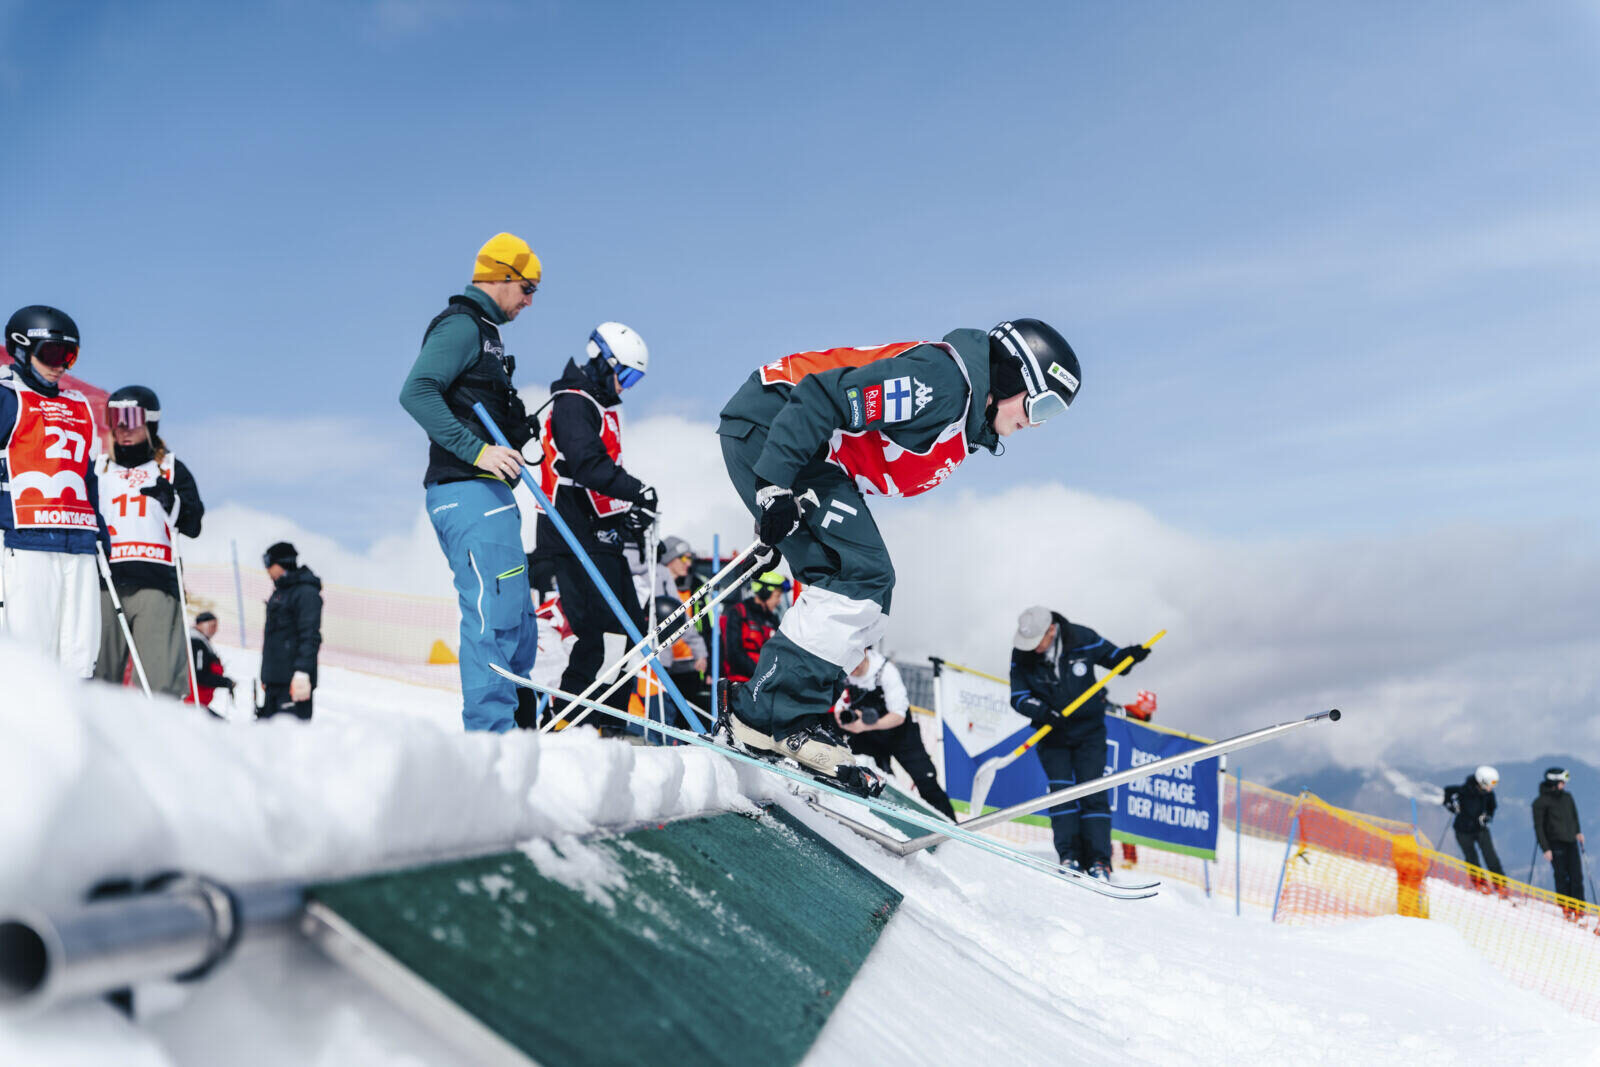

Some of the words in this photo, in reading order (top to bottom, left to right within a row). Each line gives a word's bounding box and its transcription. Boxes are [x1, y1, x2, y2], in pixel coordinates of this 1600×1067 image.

[45, 426, 86, 463] 27
[112, 494, 147, 517] 11
[34, 510, 98, 526] MONTAFON
[112, 545, 165, 559] NTAFON
[1154, 779, 1196, 805] FRAGE
[1128, 795, 1152, 819] DER
[1153, 802, 1209, 831] HALTUNG
